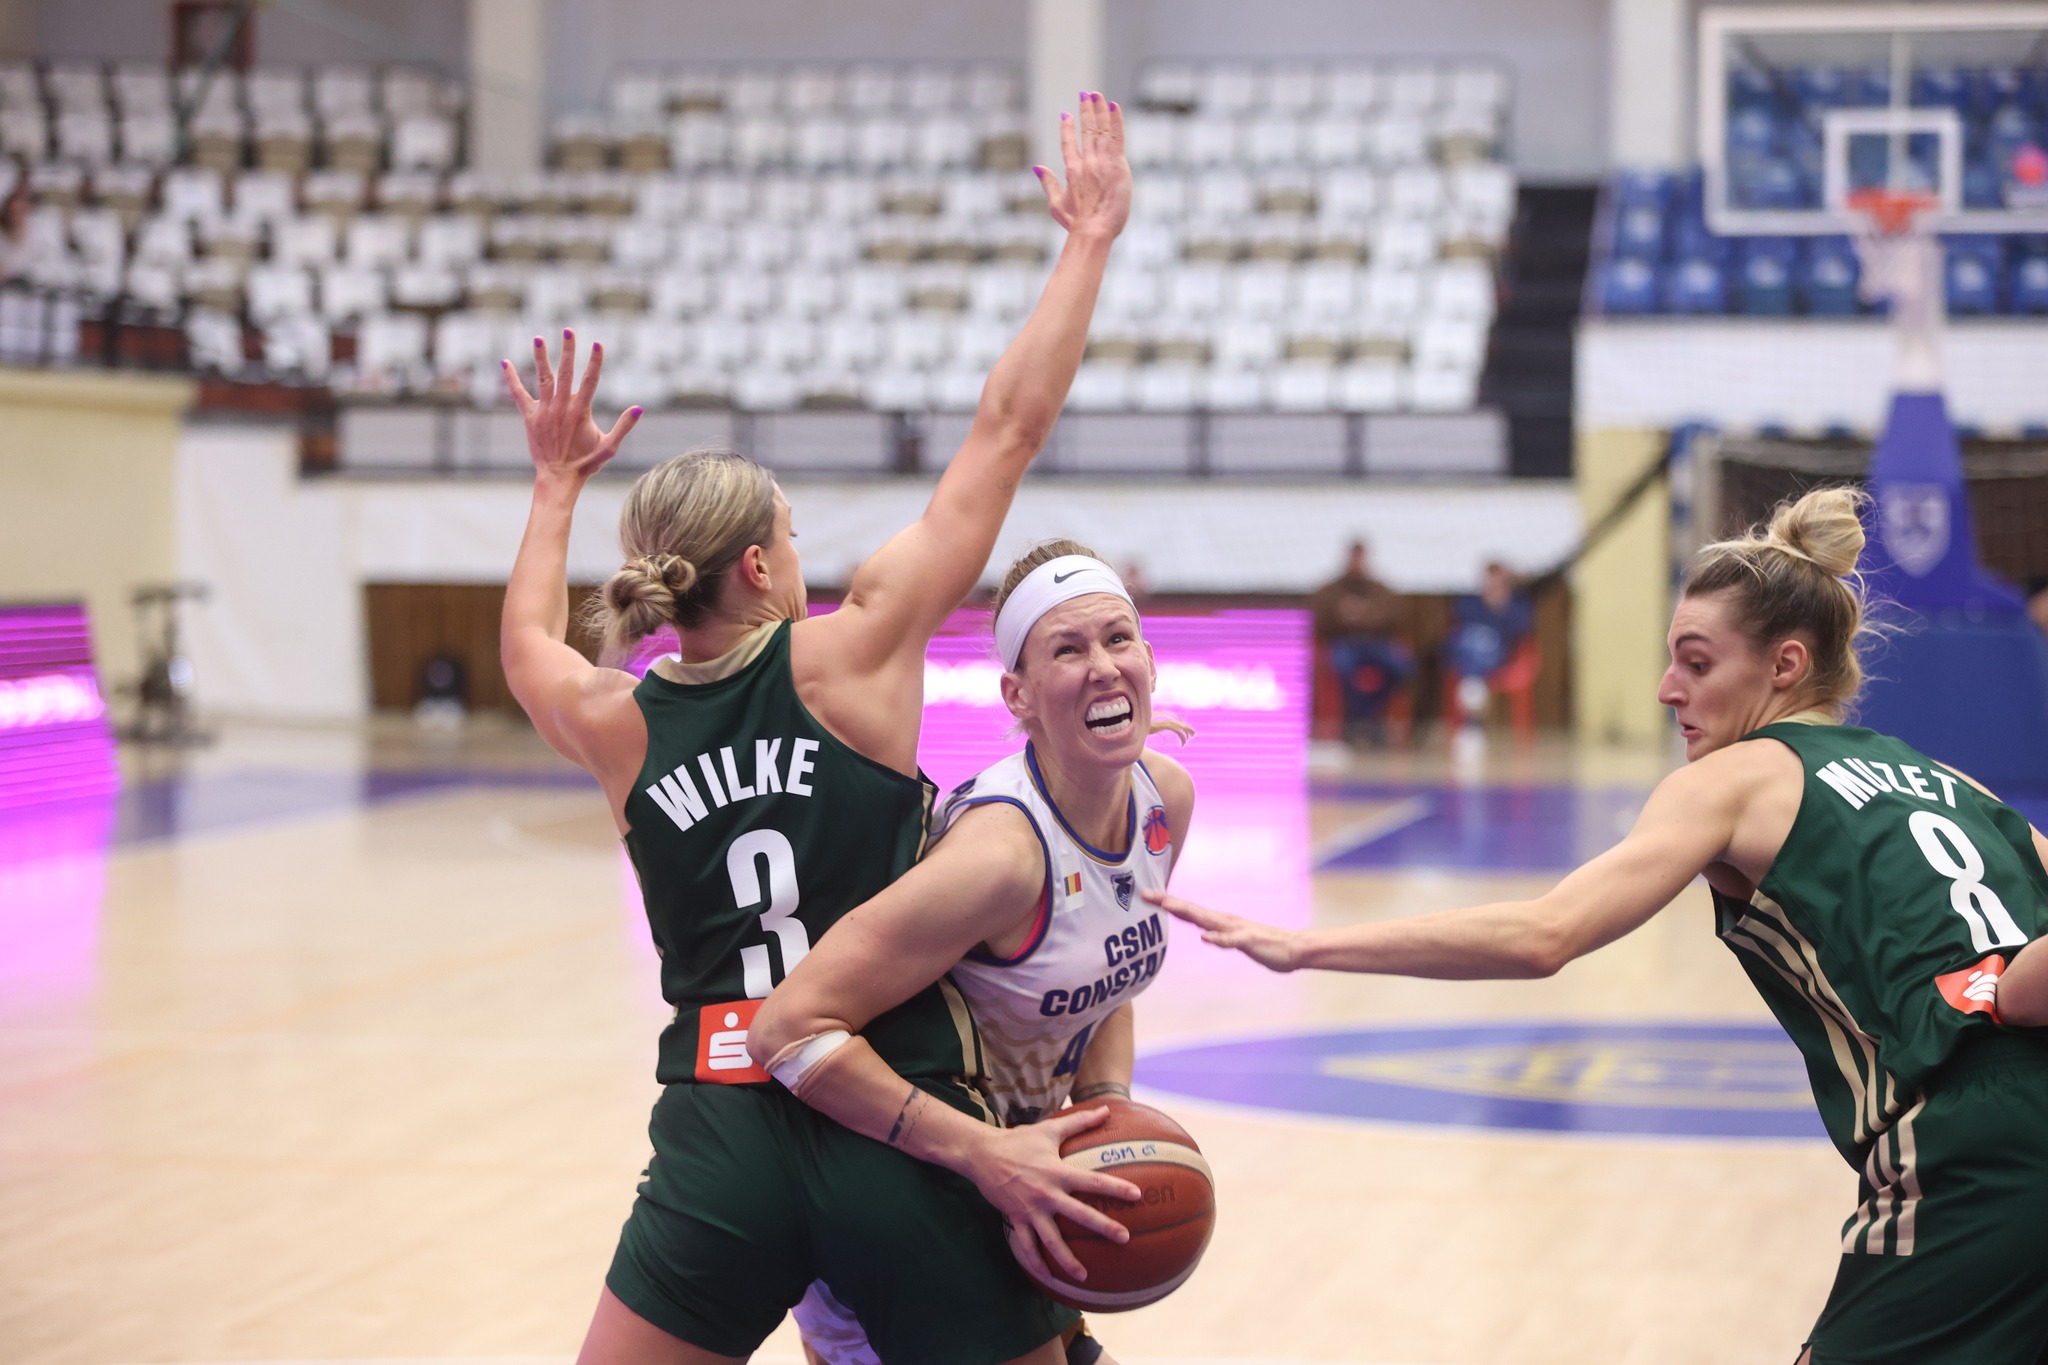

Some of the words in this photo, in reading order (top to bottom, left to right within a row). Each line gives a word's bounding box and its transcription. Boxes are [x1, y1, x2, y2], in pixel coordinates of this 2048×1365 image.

[646, 737, 820, 832] WILKE
[1815, 757, 1958, 811] MUZET
[726, 828, 811, 999] 3
[1908, 810, 2029, 954] 8
[1104, 913, 1163, 968] CSM
[1100, 1145, 1136, 1164] CSM
